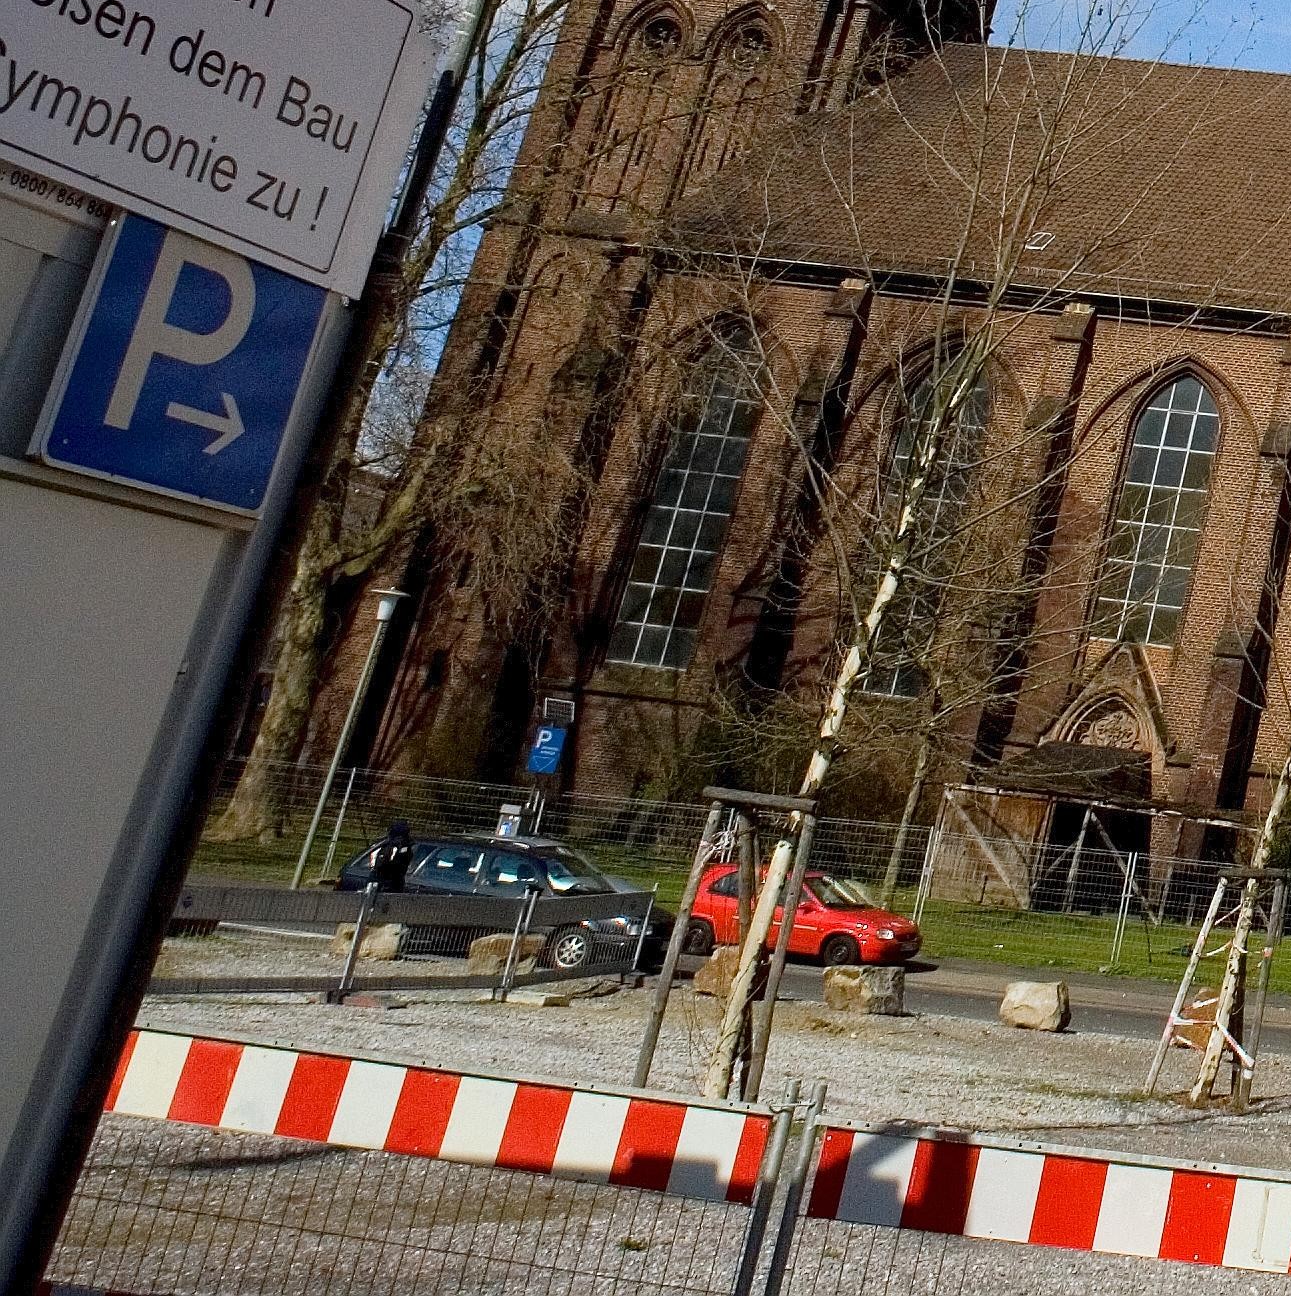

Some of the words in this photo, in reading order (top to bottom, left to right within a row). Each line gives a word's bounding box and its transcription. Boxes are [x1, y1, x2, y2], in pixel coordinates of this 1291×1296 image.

[0, 38, 239, 193] ymphonie
[246, 170, 301, 221] zu
[309, 186, 330, 231] !
[169, 29, 267, 109] dem
[276, 74, 359, 153] Bau
[103, 225, 257, 431] P
[535, 729, 553, 748] P
